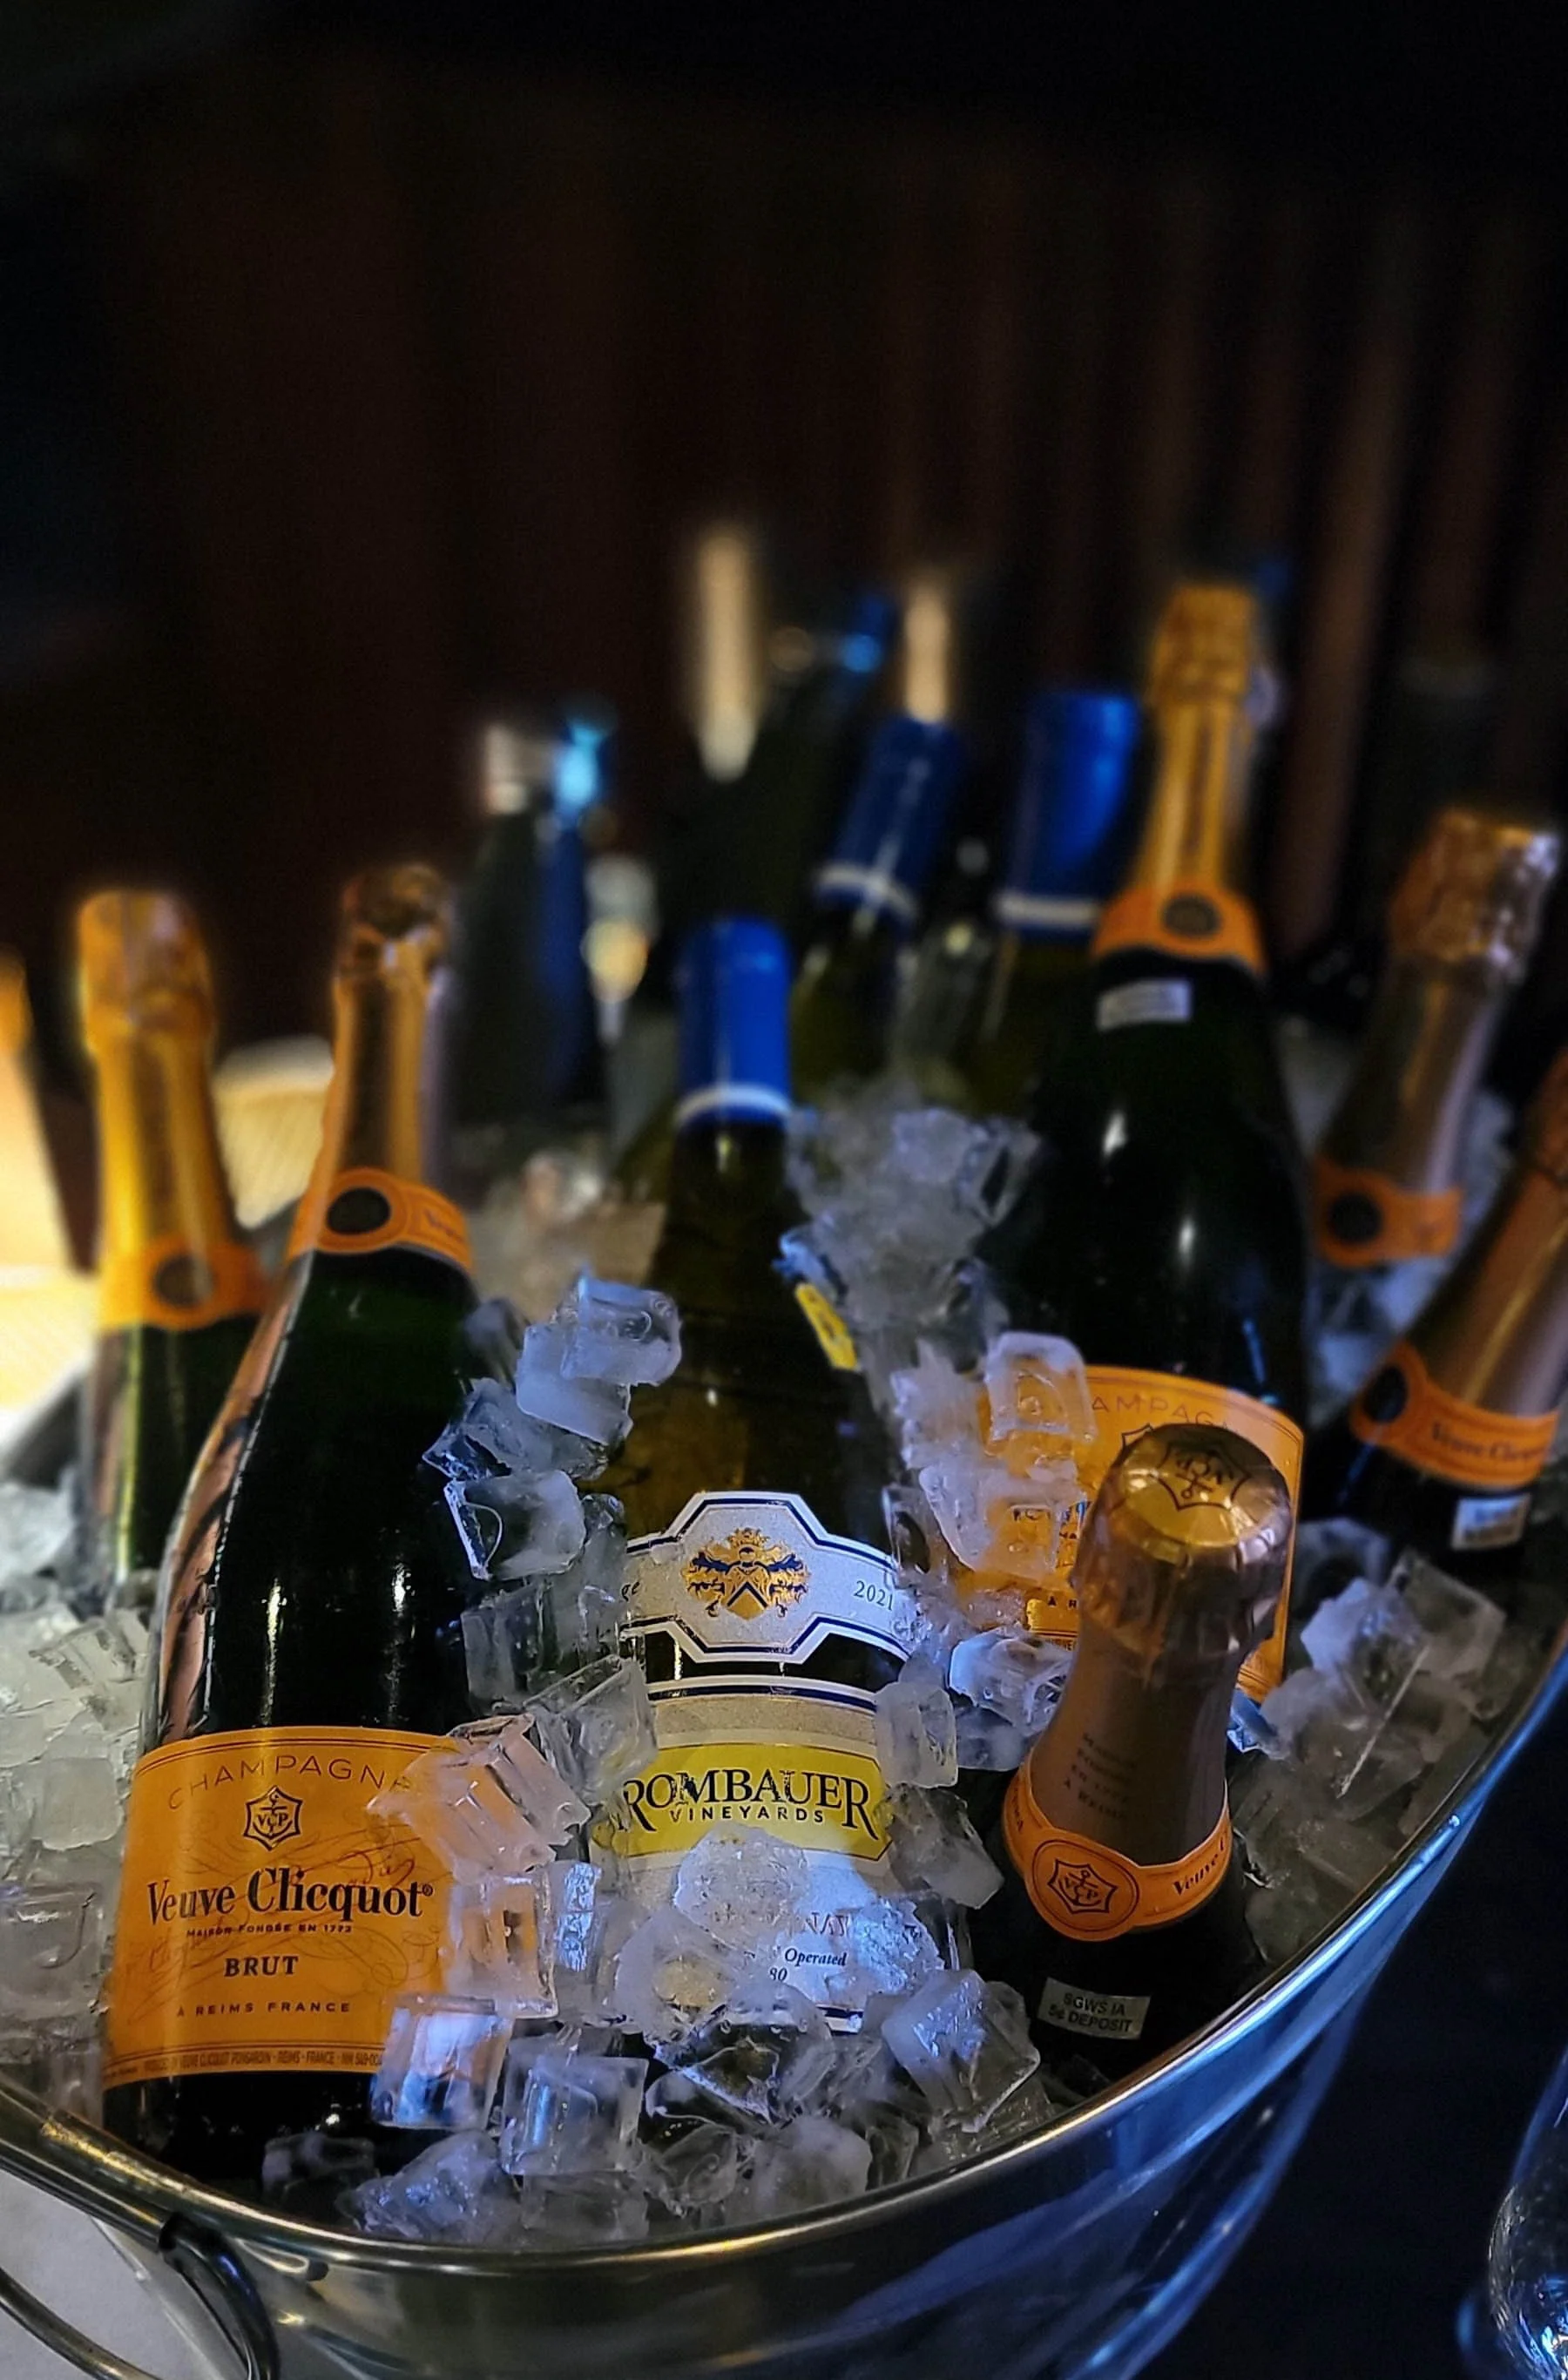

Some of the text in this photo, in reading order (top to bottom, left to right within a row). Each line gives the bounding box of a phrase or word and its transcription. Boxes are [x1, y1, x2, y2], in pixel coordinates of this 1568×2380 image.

[854, 1580, 893, 1612] 2021
[618, 1768, 879, 1841] ROMBAUER
[670, 1806, 824, 1822] VINEYARDS
[147, 1879, 235, 1925] Veuve
[298, 1924, 317, 1932] EN
[224, 1956, 299, 1978] BRUT
[785, 1948, 847, 1967] Operated
[196, 2002, 253, 2017] REIMS
[267, 2001, 350, 2013] FRANCE
[1068, 2011, 1133, 2032] DEPOSIT
